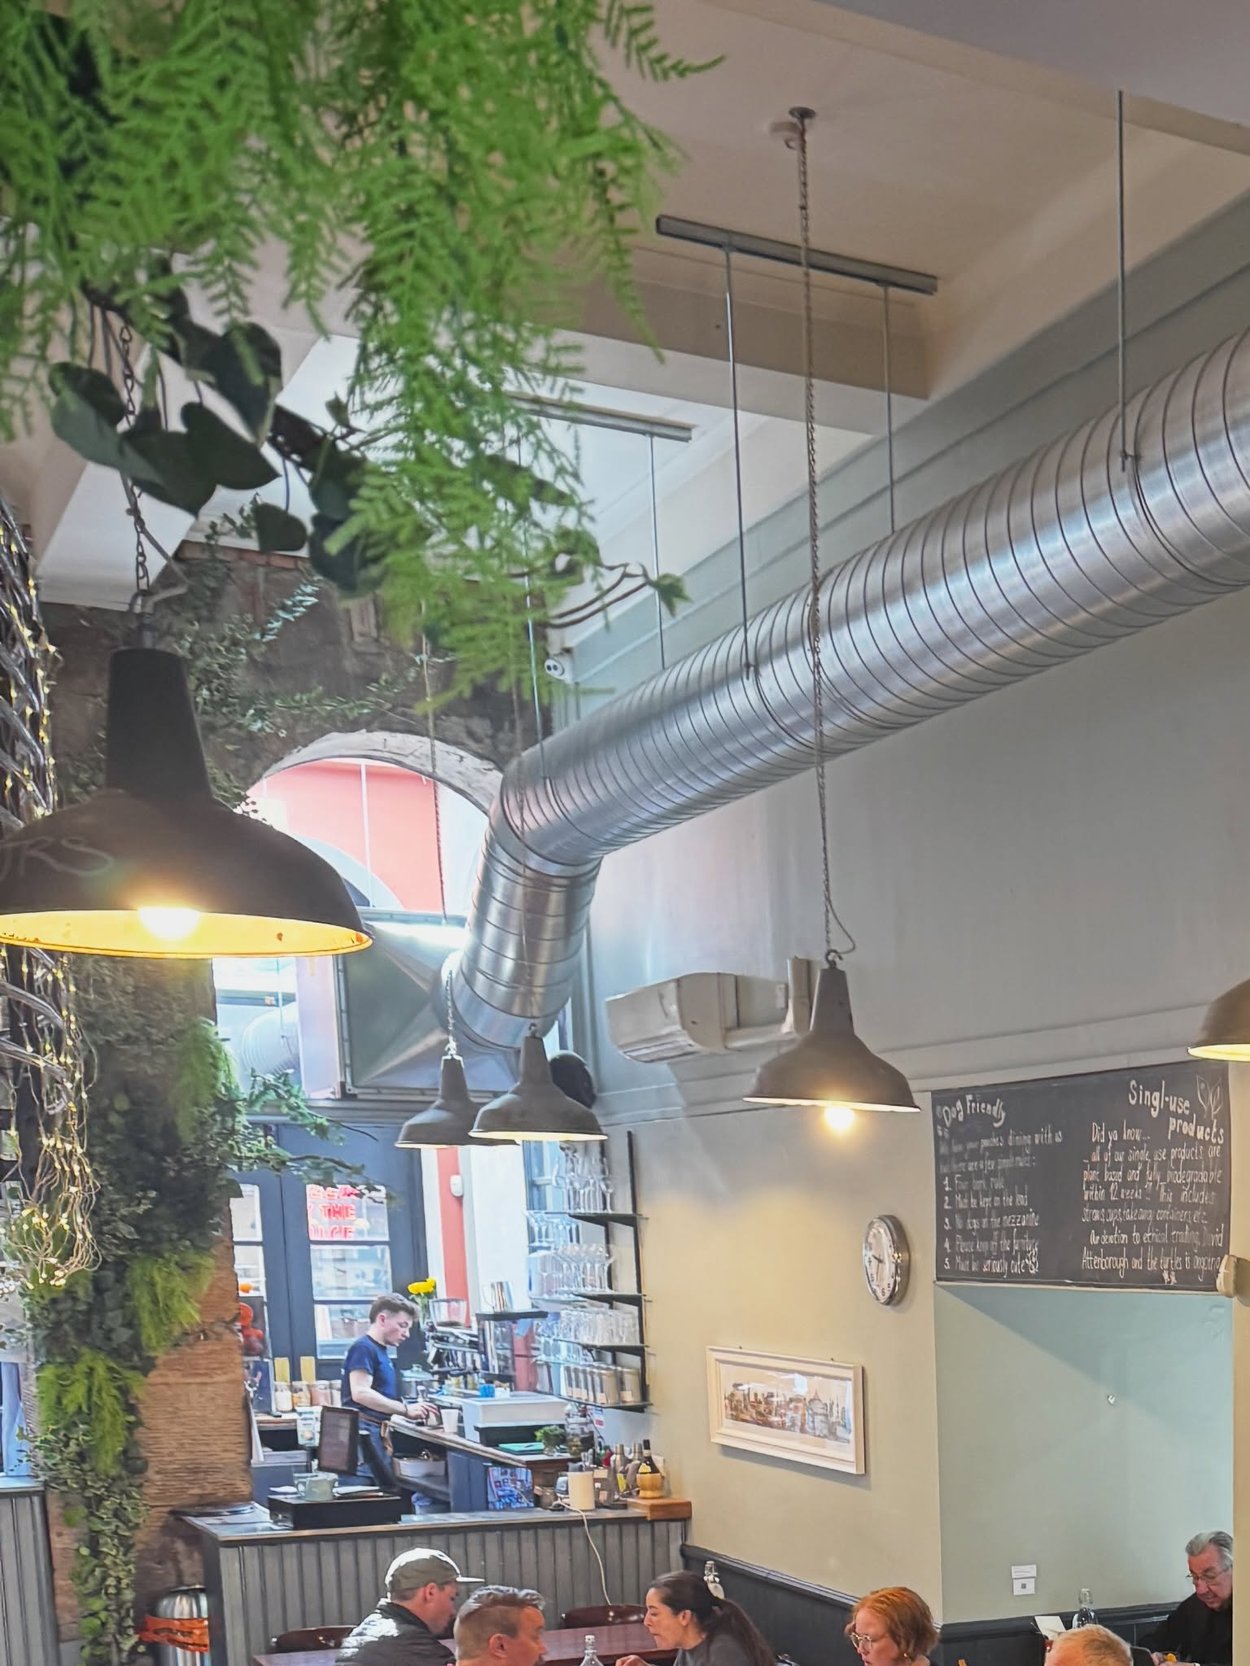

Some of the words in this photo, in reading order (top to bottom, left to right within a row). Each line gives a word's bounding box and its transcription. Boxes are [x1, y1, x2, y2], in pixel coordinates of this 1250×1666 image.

[942, 1099, 964, 1128] Dog
[965, 1094, 1006, 1128] Friendly
[1034, 1124, 1053, 1144] with
[1091, 1122, 1105, 1143] Did
[1167, 1112, 1225, 1144] products
[1170, 1141, 1204, 1168] products
[1208, 1144, 1221, 1158] are
[1002, 1189, 1014, 1207] the
[322, 1203, 356, 1220] THE
[1132, 1223, 1141, 1244] to
[1081, 1246, 1130, 1279] Attenborough
[1131, 1246, 1144, 1271] and
[1147, 1245, 1158, 1271] the
[1160, 1246, 1183, 1271] turtles
